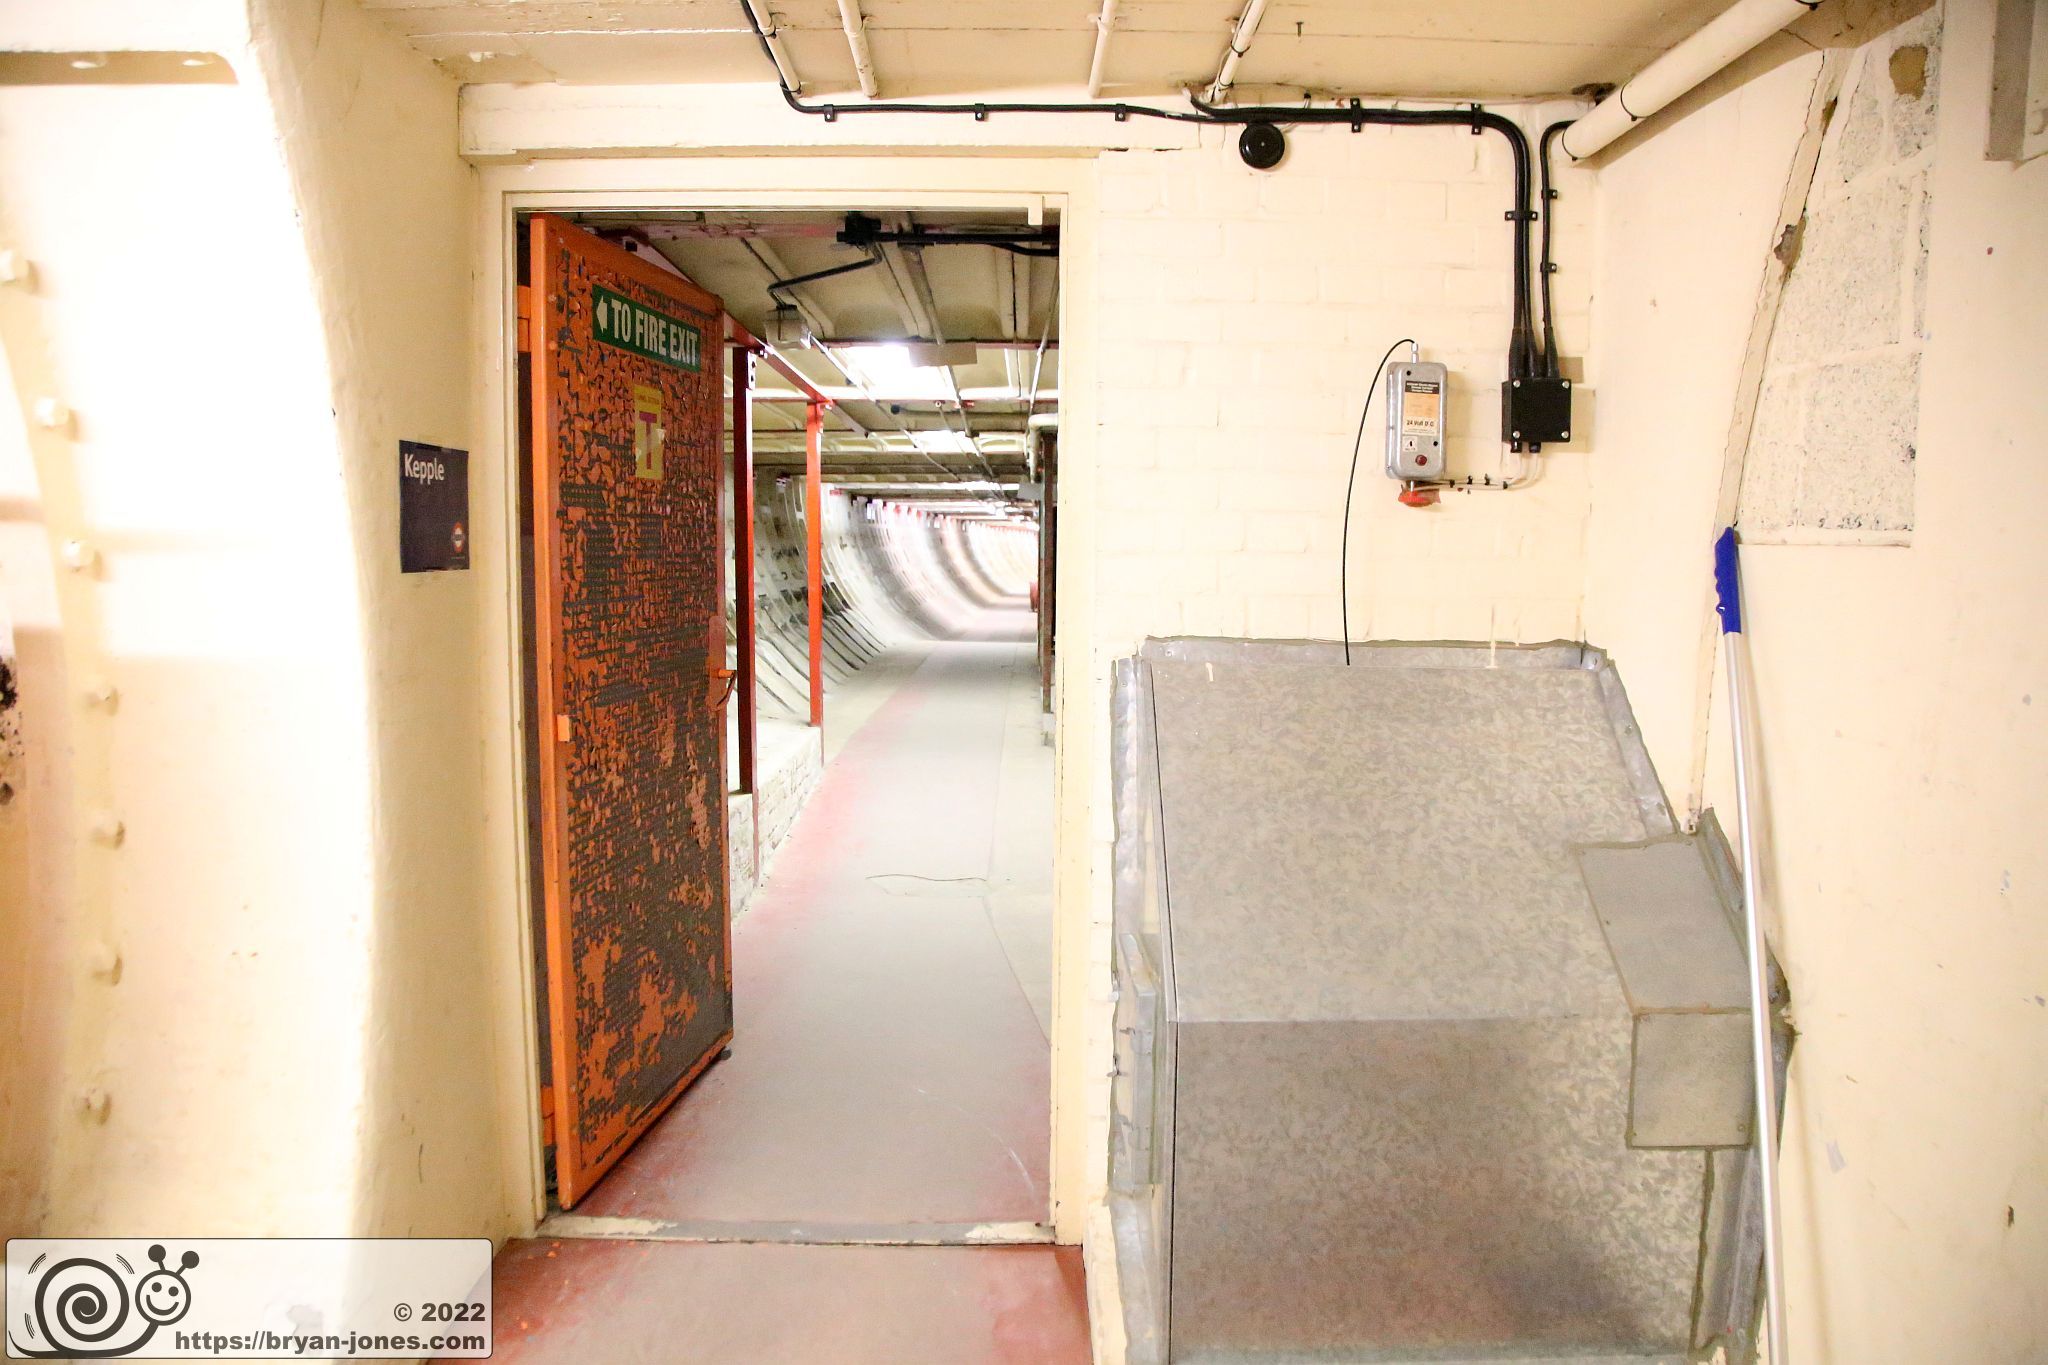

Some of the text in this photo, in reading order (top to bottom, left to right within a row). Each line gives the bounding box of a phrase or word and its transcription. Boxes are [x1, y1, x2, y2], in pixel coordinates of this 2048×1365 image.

[611, 298, 698, 366] TO FIRE EXIT
[404, 453, 445, 485] Kepple
